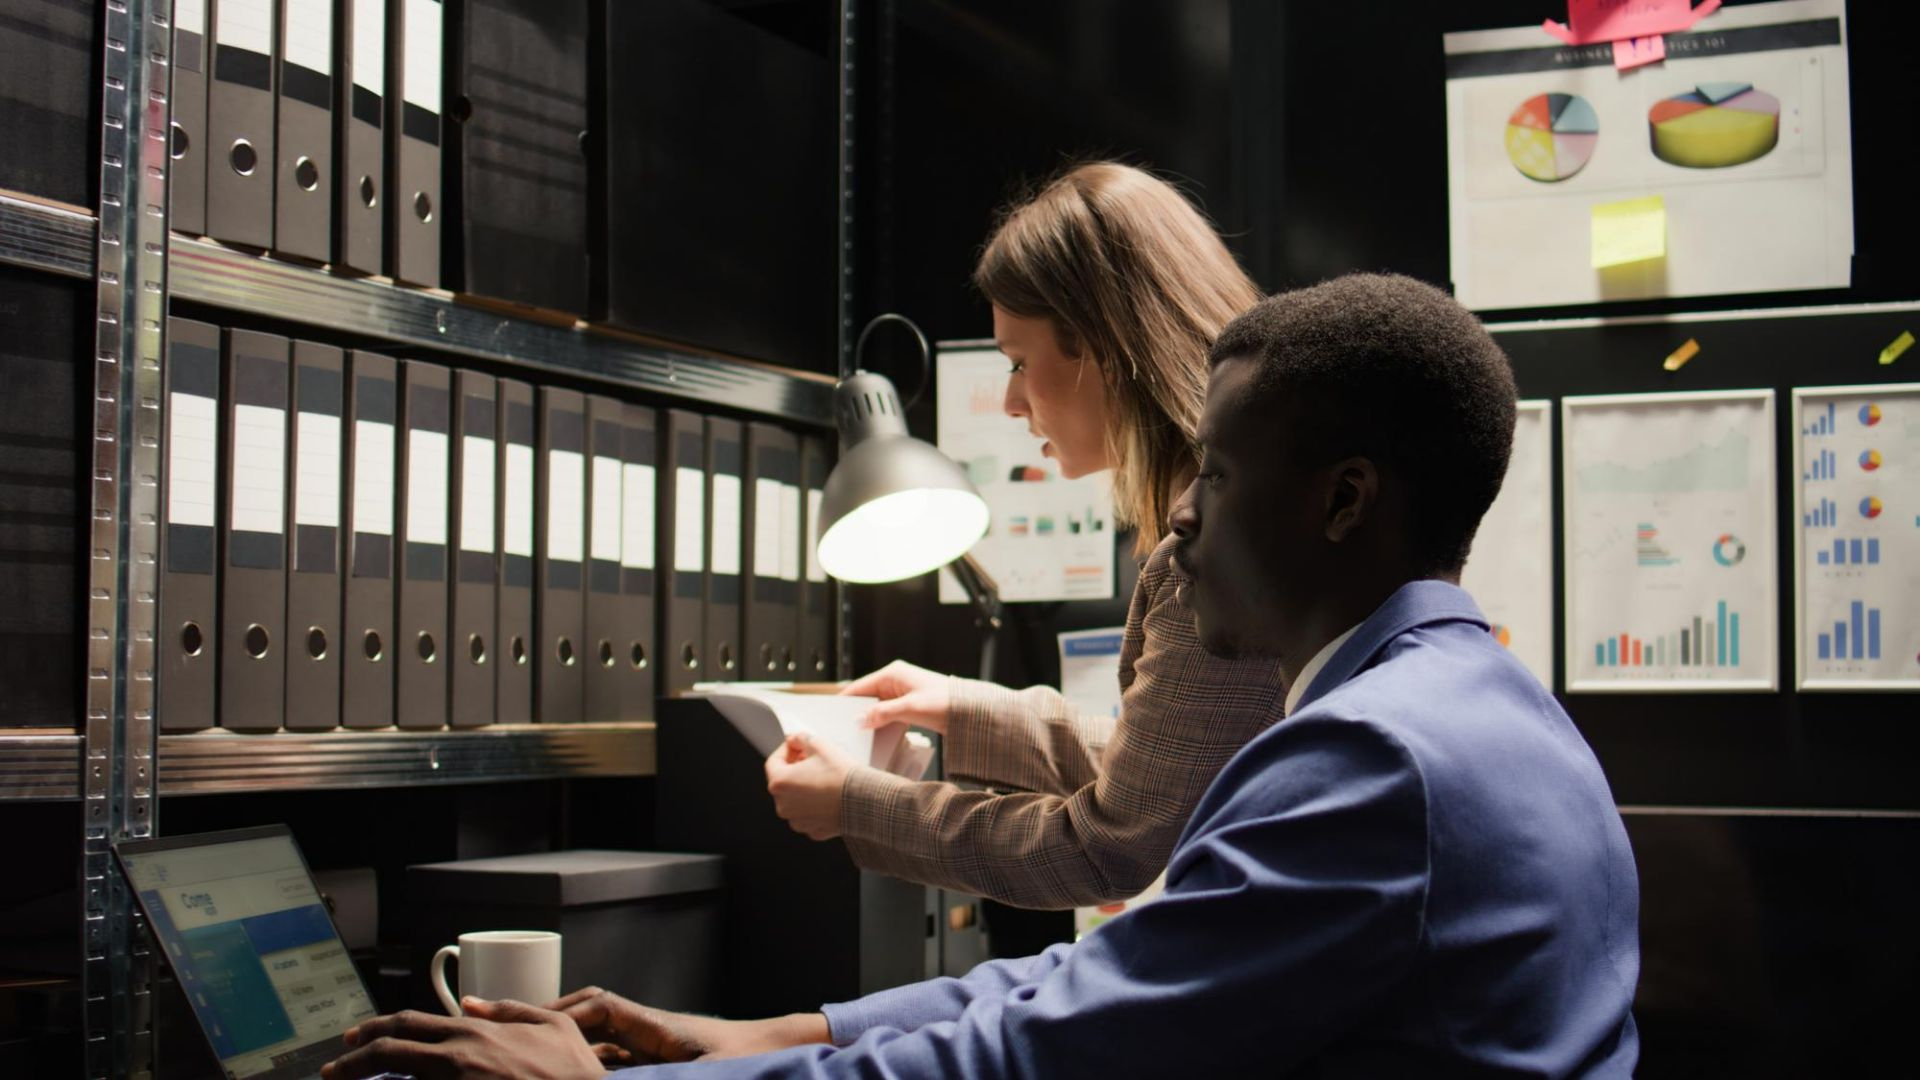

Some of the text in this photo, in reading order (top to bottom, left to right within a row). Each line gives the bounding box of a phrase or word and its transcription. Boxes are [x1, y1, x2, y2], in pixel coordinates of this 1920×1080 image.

[1554, 48, 1611, 63] BUSINES
[1667, 39, 1700, 52] TICS
[1705, 37, 1726, 49] 101
